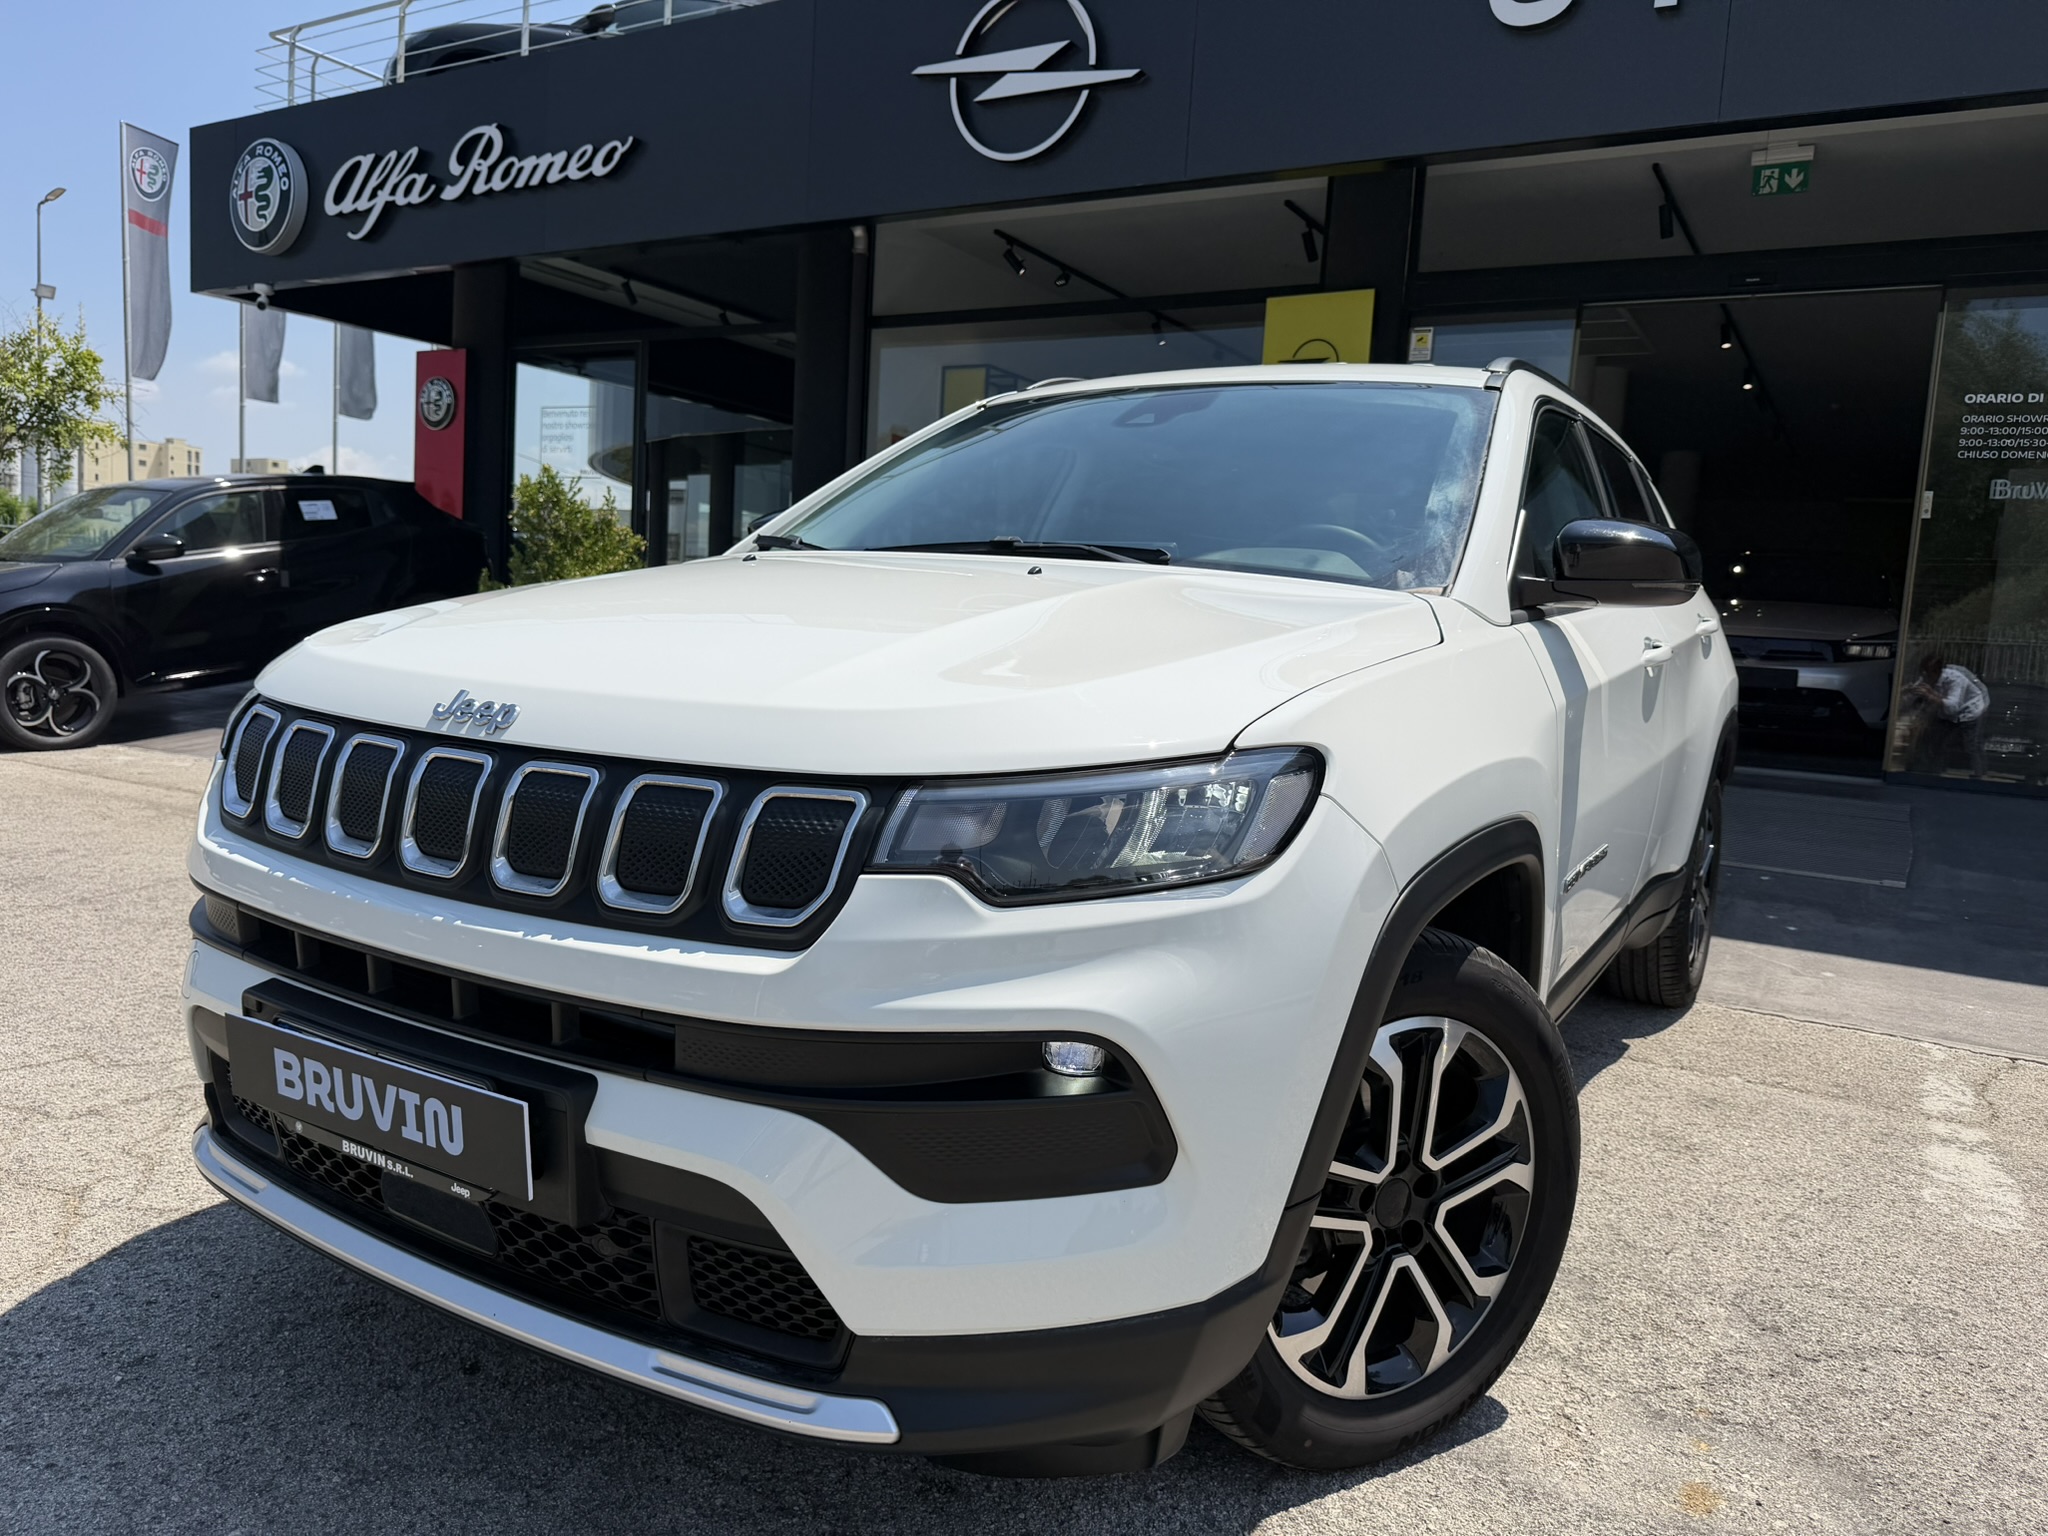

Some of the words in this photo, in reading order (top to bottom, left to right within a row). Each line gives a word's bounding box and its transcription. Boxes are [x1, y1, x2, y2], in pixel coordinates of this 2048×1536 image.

[255, 145, 290, 191] ROMEO
[324, 146, 436, 240] Alfa
[440, 123, 634, 200] Romeo
[1964, 393, 2024, 404] ORARIO
[2027, 392, 2044, 403] DI
[1962, 414, 2005, 423] ORARIO
[1957, 450, 1999, 459] CHIUSO
[433, 689, 521, 735] Jeep
[273, 1047, 465, 1156] BRUVIN
[342, 1139, 386, 1168] BRUVIN
[386, 1160, 414, 1178] S.R.L.
[451, 1182, 471, 1198] Jeep
